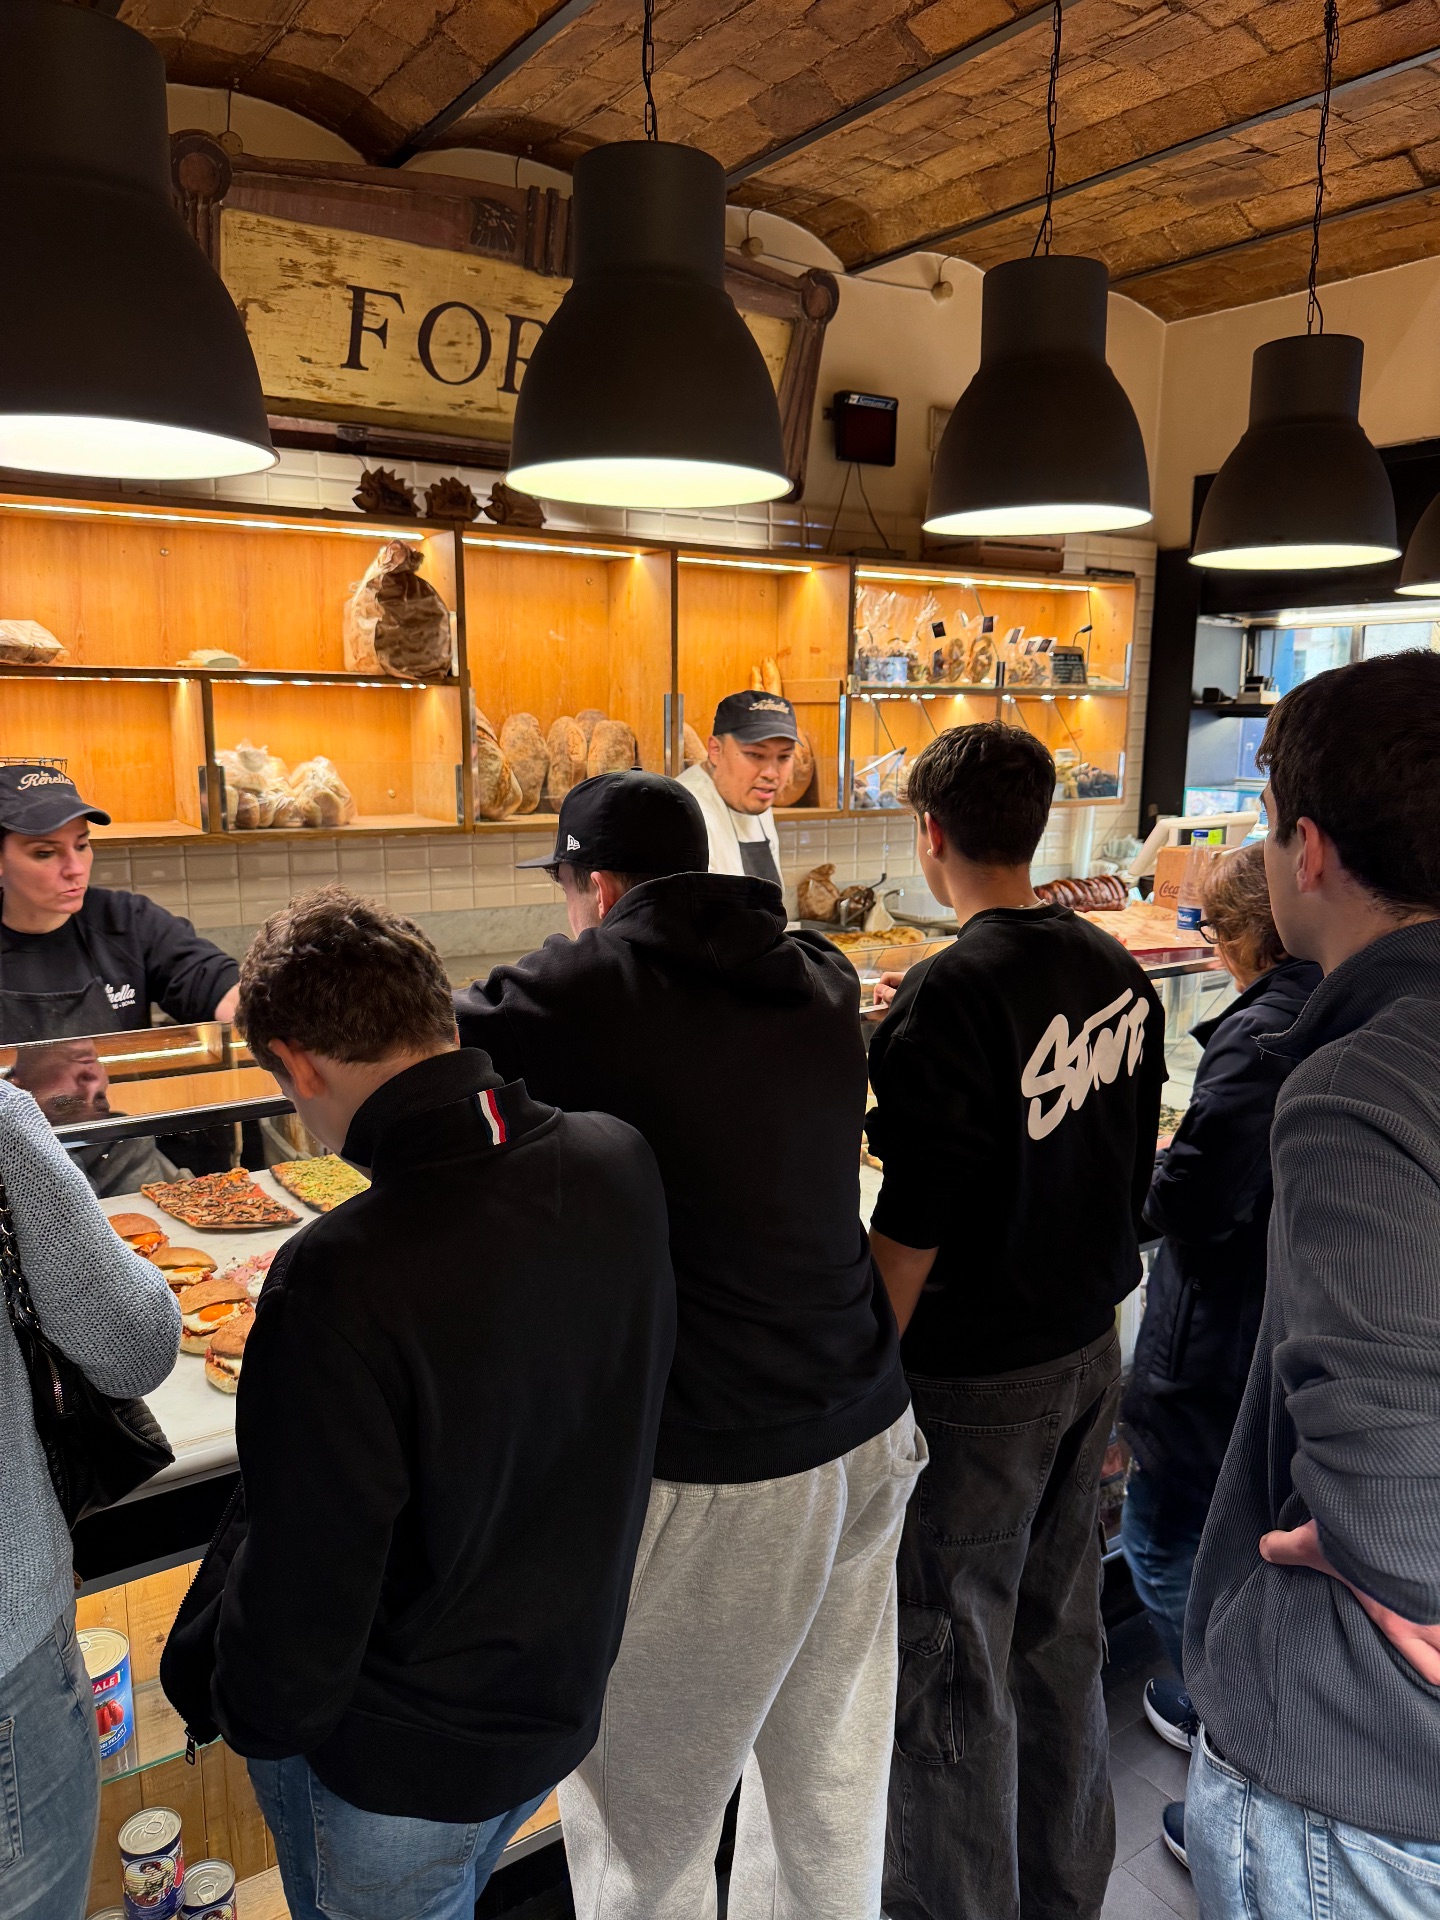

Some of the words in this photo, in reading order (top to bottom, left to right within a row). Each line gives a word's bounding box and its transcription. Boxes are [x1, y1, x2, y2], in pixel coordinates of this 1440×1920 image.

[17, 772, 75, 791] Renella
[107, 983, 136, 1004] nella
[92, 1676, 116, 1694] ALE
